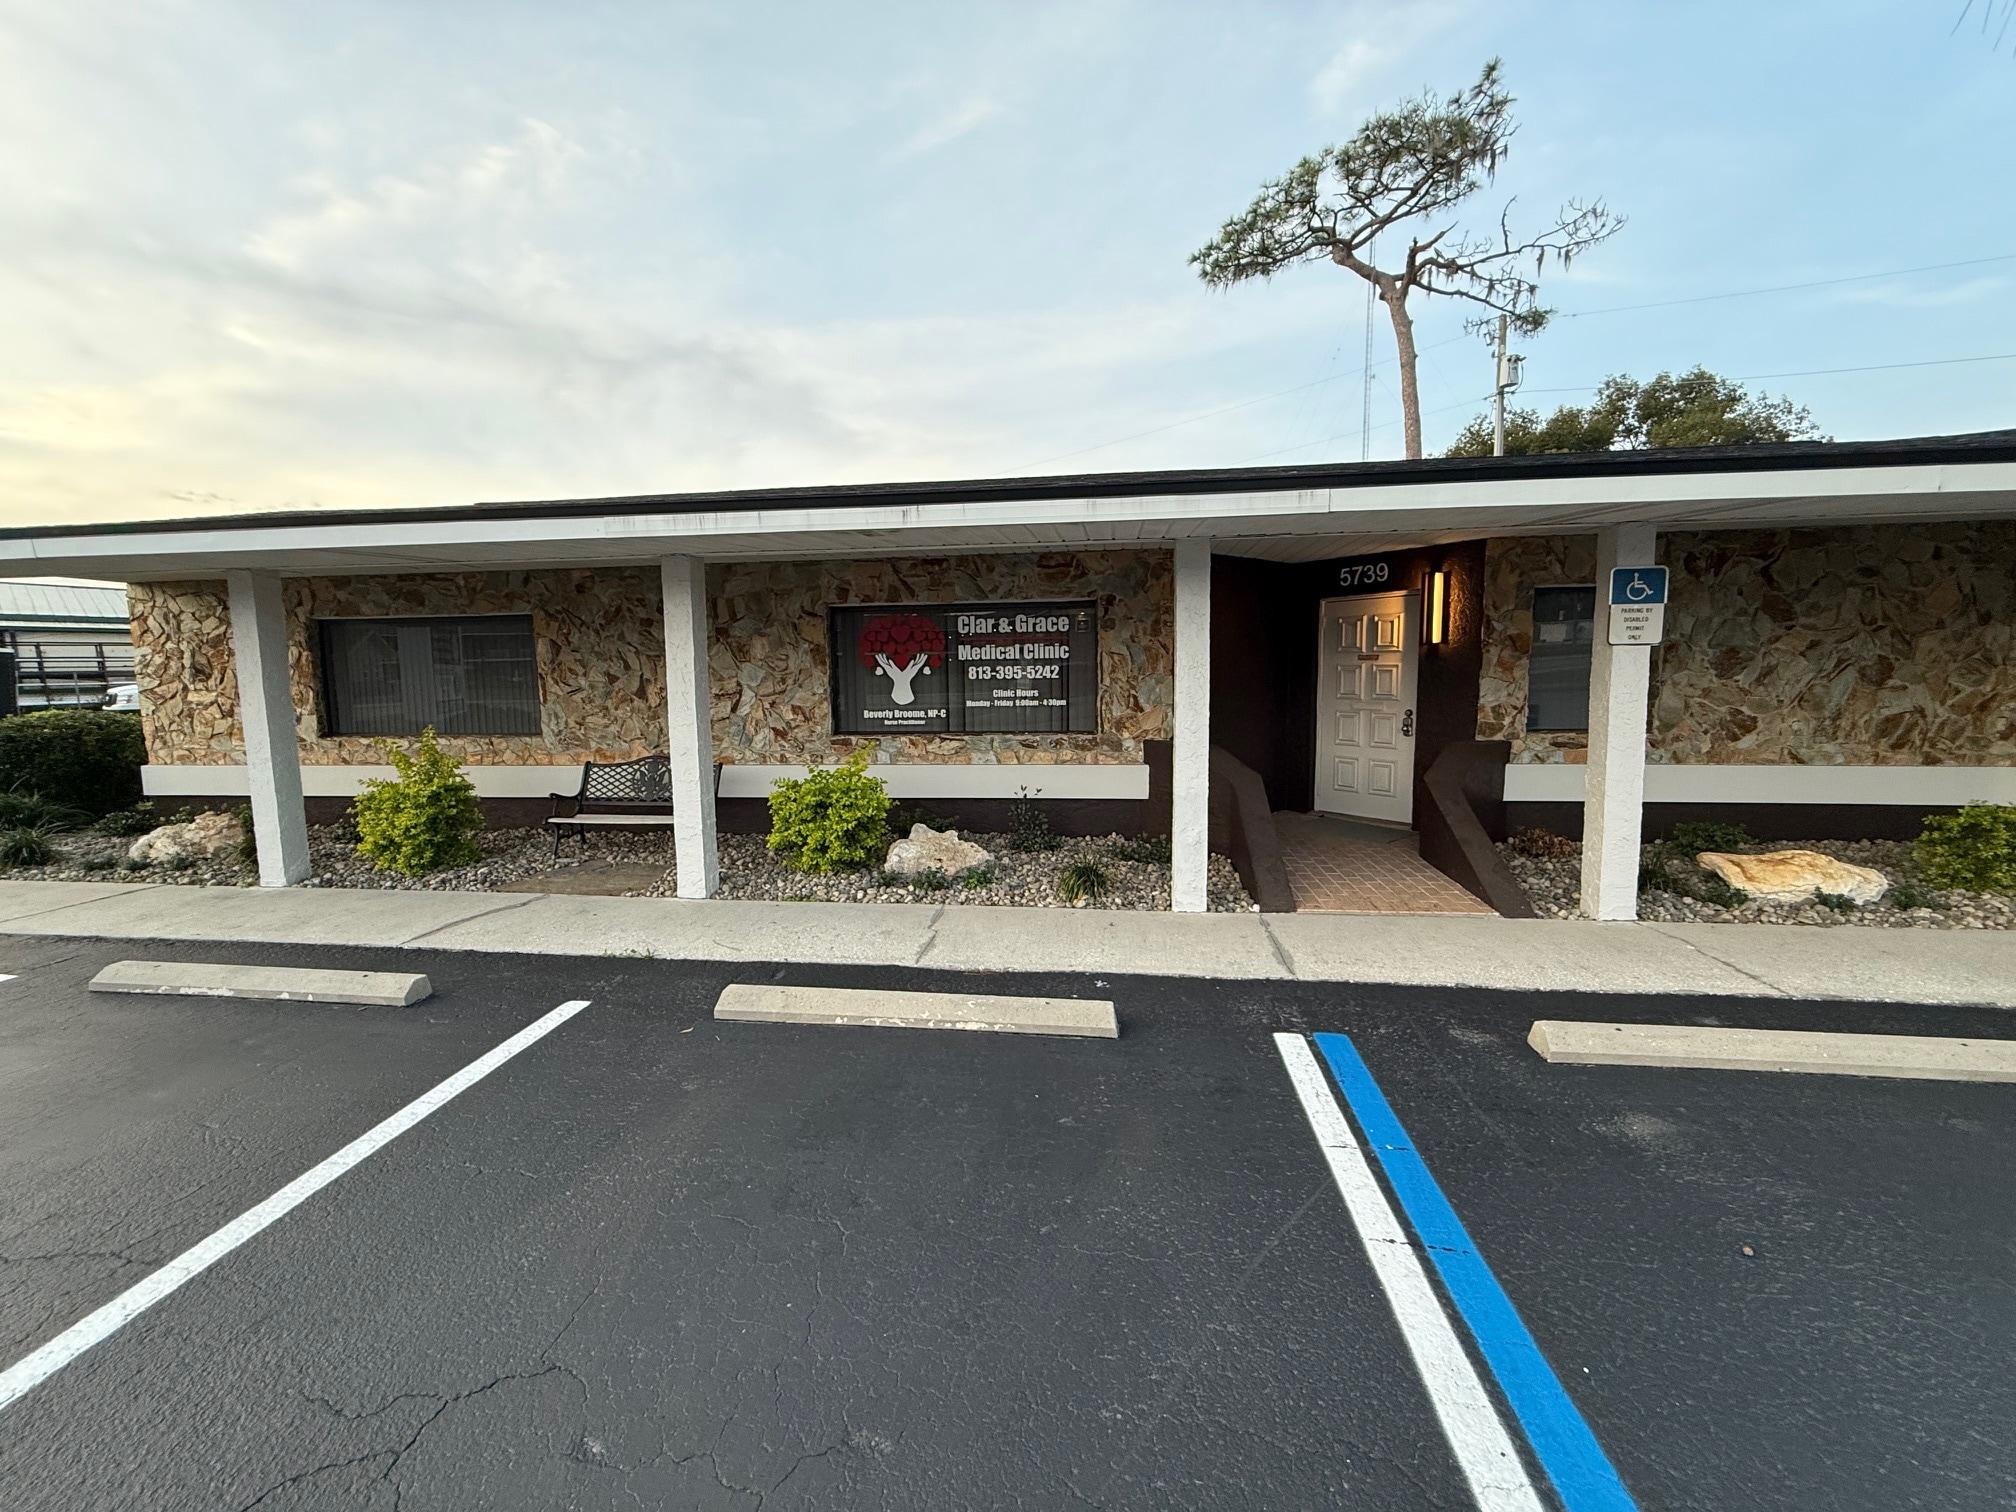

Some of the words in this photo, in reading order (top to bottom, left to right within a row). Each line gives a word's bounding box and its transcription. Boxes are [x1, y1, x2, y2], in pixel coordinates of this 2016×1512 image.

[1340, 563, 1389, 587] 5739
[957, 616, 994, 634] Clar
[998, 617, 1012, 633] &
[1015, 614, 1070, 633] Grace
[957, 643, 1020, 660] Medical
[1023, 643, 1070, 660] Clinic
[968, 665, 1060, 680] 813-395-5242
[993, 689, 1016, 697] Clinic
[1016, 689, 1039, 697] Hours
[863, 709, 893, 719] Beverly
[894, 709, 927, 719] Broome,
[927, 709, 947, 718] NP-C
